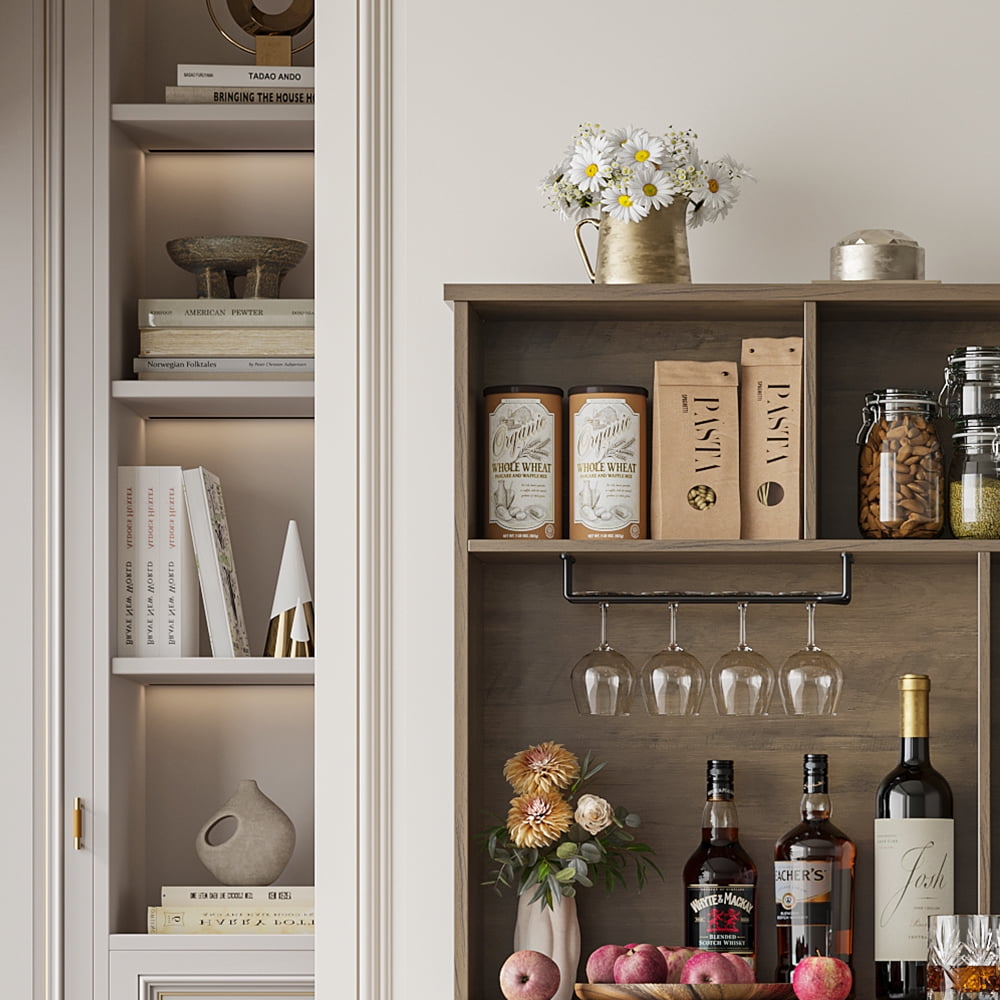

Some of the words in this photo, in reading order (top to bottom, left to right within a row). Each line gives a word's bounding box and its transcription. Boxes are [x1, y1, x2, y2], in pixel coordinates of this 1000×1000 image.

[248, 72, 277, 81] TADAO
[278, 73, 302, 81] ANDO
[213, 91, 255, 103] BRINGING
[257, 92, 274, 103] THE
[276, 92, 304, 104] HOUSE
[306, 92, 315, 104] H
[147, 360, 185, 369] Norwegian
[186, 360, 217, 368] Folktales
[766, 384, 791, 464] PASTA
[492, 414, 547, 458] Organic
[577, 414, 632, 458] Organic
[693, 397, 721, 473] PASTA
[492, 462, 520, 473] WHOLE
[521, 462, 552, 474] WHEAT
[577, 462, 606, 473] WHOLE
[606, 462, 638, 474] WHEAT
[775, 868, 824, 881] ACHER'S
[880, 841, 947, 929] Josh
[689, 894, 719, 913] WHYTE
[717, 894, 724, 904] &
[723, 891, 754, 914] MACKAY
